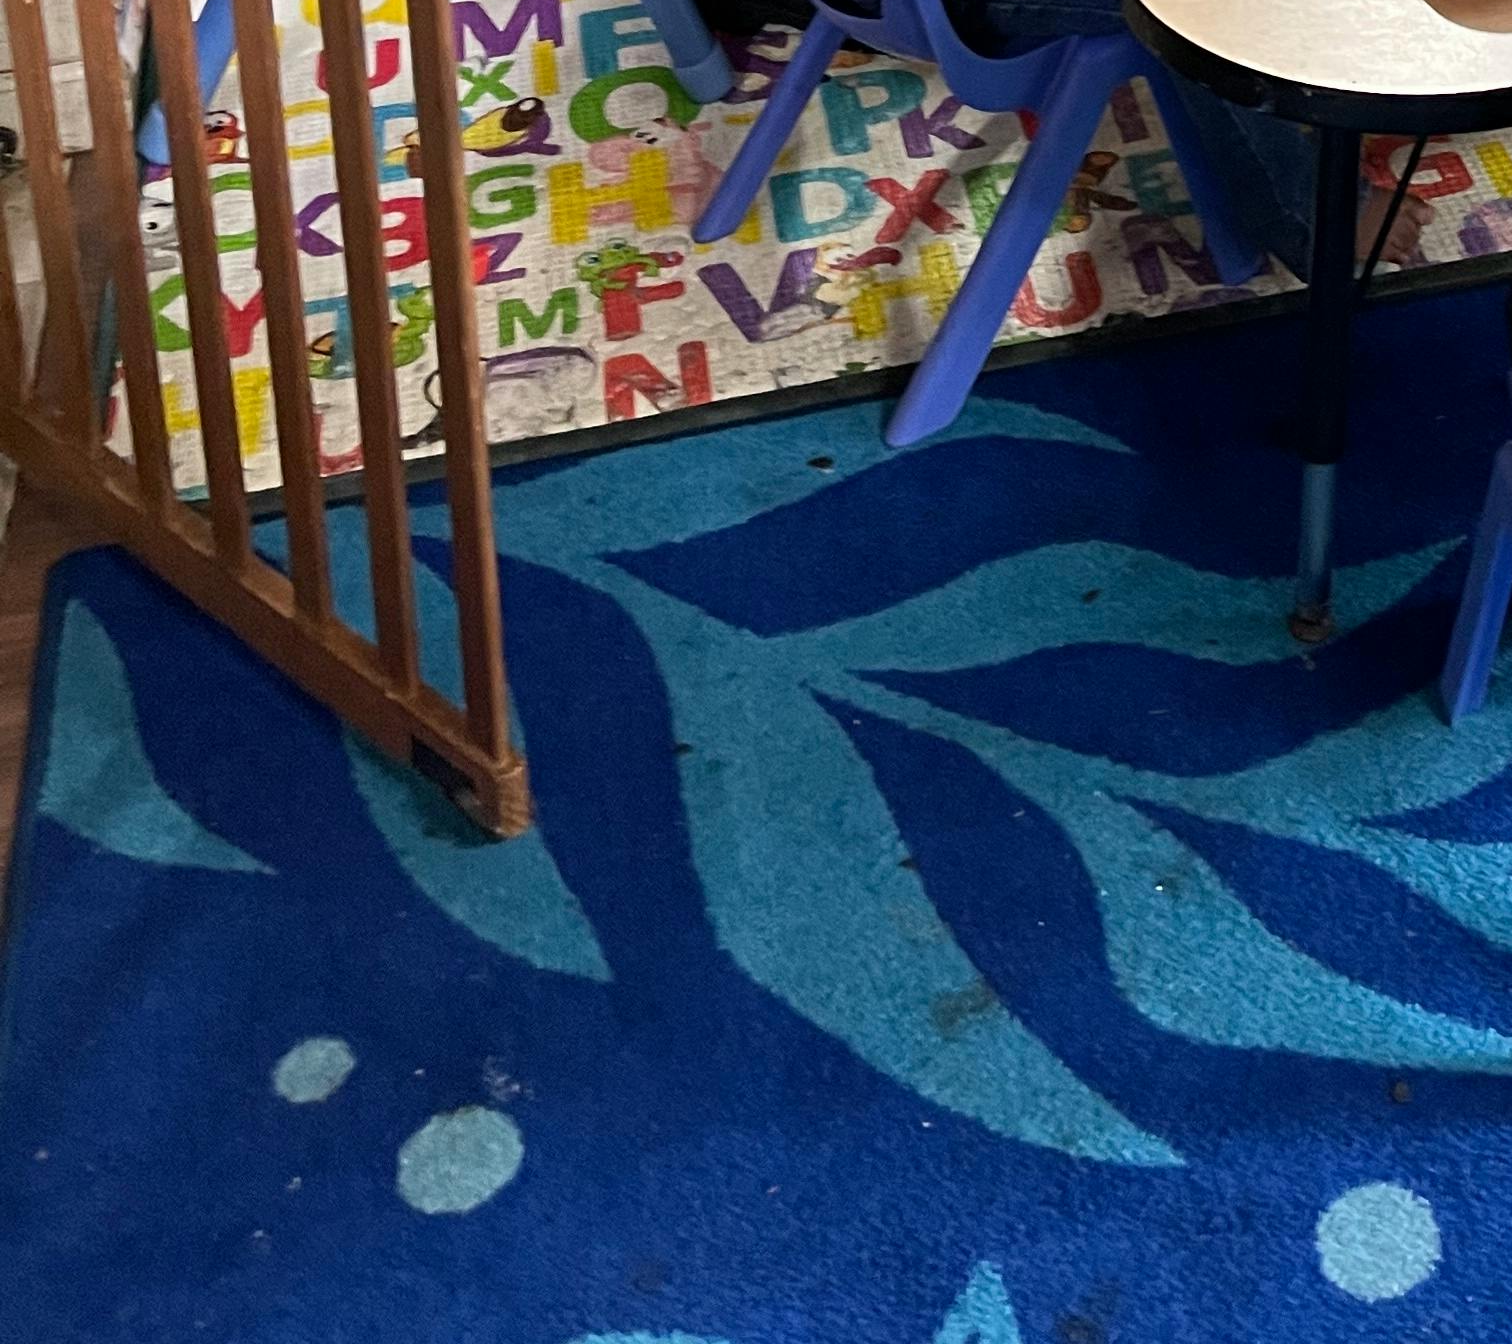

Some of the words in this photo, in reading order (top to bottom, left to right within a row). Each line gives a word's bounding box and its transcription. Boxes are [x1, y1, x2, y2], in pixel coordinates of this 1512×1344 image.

[820, 67, 929, 157] P
[899, 95, 986, 159] K
[468, 162, 538, 229] G
[546, 146, 673, 246] H
[768, 165, 879, 244] D
[865, 168, 965, 244] X
[499, 286, 579, 348] M
